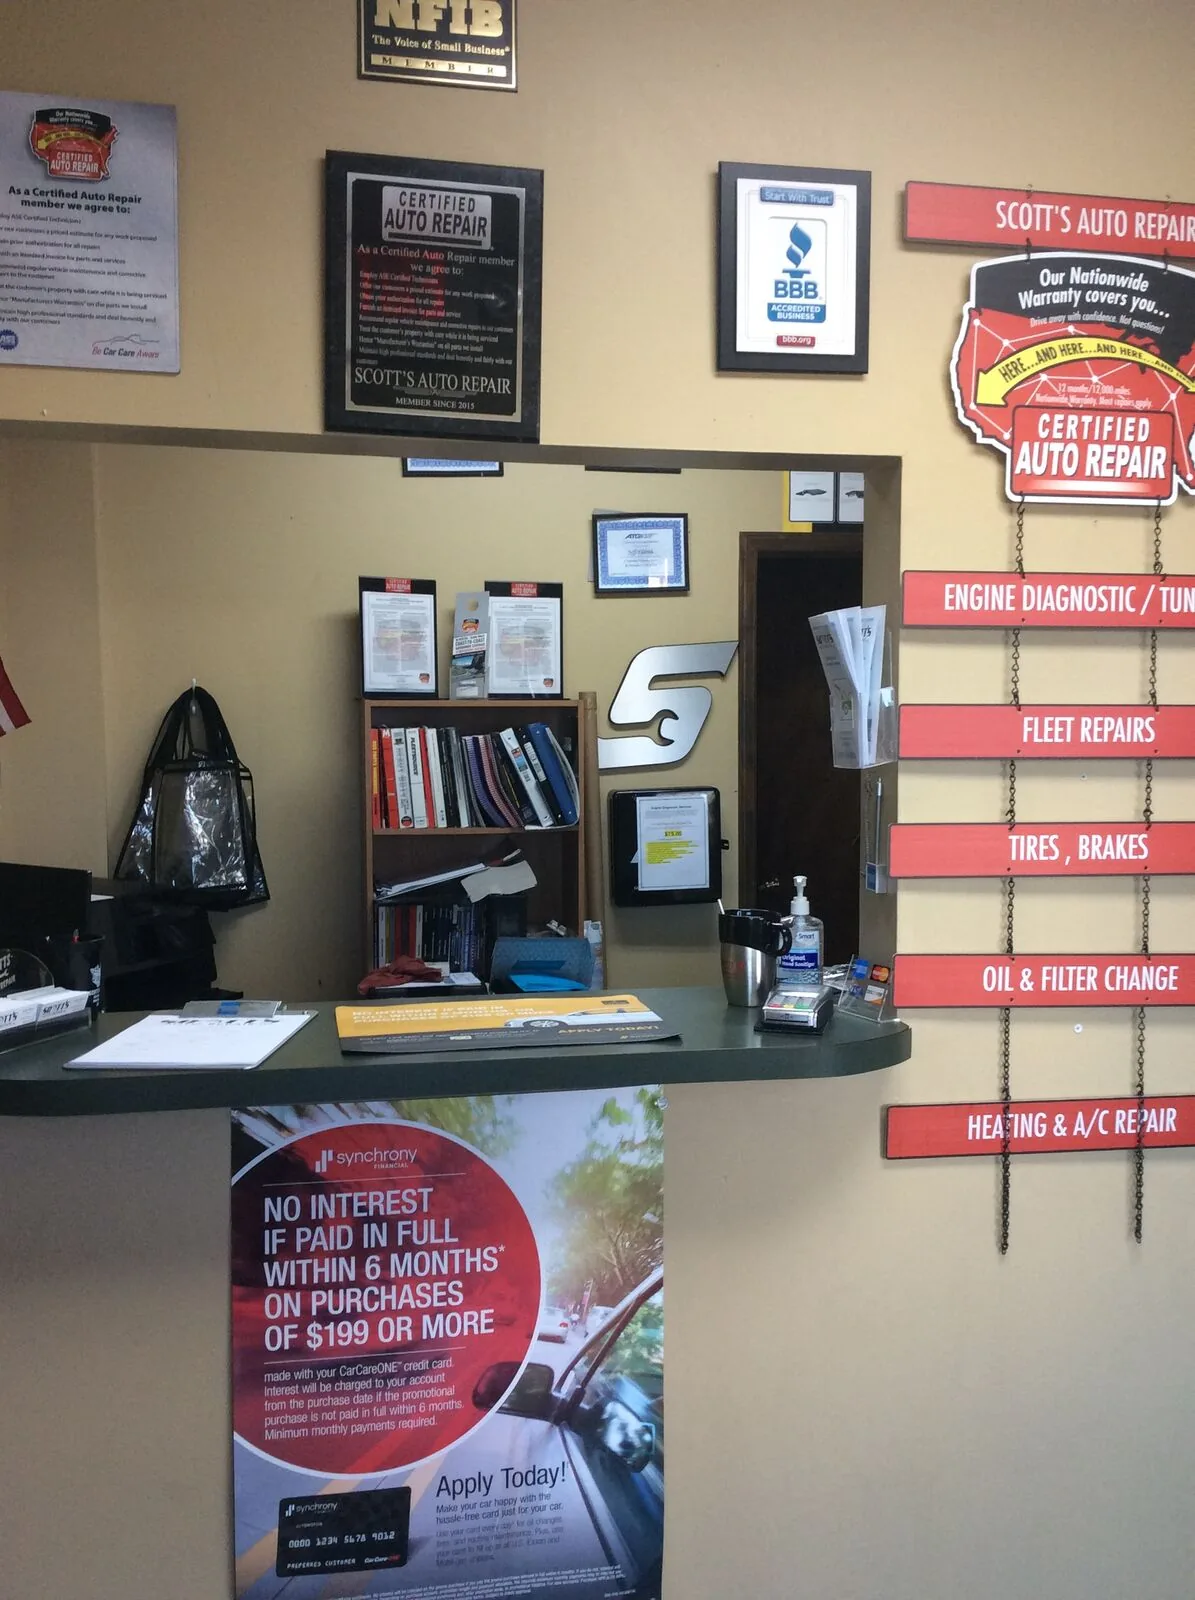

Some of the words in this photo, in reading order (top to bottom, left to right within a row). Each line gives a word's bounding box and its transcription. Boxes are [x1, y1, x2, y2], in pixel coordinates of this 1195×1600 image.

[374, 0, 503, 37] NFIB
[371, 34, 391, 46] The
[394, 37, 419, 49] Voice
[421, 39, 432, 50] of
[434, 41, 461, 53] Small
[50, 159, 70, 171] AUTO
[72, 162, 99, 173] REPAIR
[8, 185, 21, 196] As
[24, 188, 30, 197] a
[32, 186, 78, 200] Certified
[81, 191, 106, 202] Auto
[108, 192, 142, 206] Repair
[21, 199, 65, 210] member
[67, 202, 82, 211] we
[84, 204, 114, 215] agree
[116, 204, 131, 214] to:
[399, 190, 476, 213] CERTIFIED
[765, 191, 786, 201] Start
[788, 192, 807, 203] With
[810, 194, 830, 204] Trust
[384, 207, 427, 232] AUTO
[432, 212, 488, 238] REPAIR
[996, 200, 1072, 234] SCOTT'S
[1077, 207, 1129, 238] AUTO
[1134, 211, 1195, 243] REPAIR
[357, 243, 371, 255] As
[372, 246, 379, 255] a
[380, 245, 421, 259] Certified
[422, 249, 445, 261] Auto
[447, 251, 477, 265] Repair
[478, 253, 516, 267] member
[410, 263, 424, 273] we
[425, 264, 450, 276] agree
[1039, 268, 1066, 287] Our
[1069, 266, 1150, 293] Nationwide
[774, 279, 819, 300] BBB
[1018, 287, 1083, 311] Warranty
[1085, 288, 1128, 307] covers
[771, 304, 821, 313] ACCREDITED
[776, 311, 815, 320] BUSINESS
[1029, 316, 1048, 328] Drive
[1067, 310, 1081, 322] with
[103, 347, 117, 357] Car
[118, 347, 136, 358] Care
[782, 335, 812, 346] bbb.org
[355, 366, 415, 388] SCOTT'S
[418, 371, 458, 391] AUTO
[462, 375, 512, 395] REPAIR
[396, 397, 431, 408] MEMBER
[432, 398, 457, 410] SINCE
[459, 401, 475, 411] 2015
[1038, 412, 1151, 443] CERTIFIED
[1014, 440, 1079, 477] AUTO
[1085, 443, 1168, 480] REPAIR
[943, 583, 1017, 612] ENGINE
[1022, 585, 1137, 613] DIAGNOSTIC
[1022, 716, 1076, 743] FLEET
[1079, 716, 1157, 744] REPAIRS
[1008, 834, 1060, 862] TIRES
[1078, 833, 1150, 862] BRAKES
[982, 966, 1014, 992] OIL
[1019, 967, 1035, 992] &
[1041, 966, 1098, 992] FILTER
[1104, 965, 1180, 992] CHANGE
[1053, 1114, 1067, 1137] &
[1073, 1108, 1110, 1139] A/C
[1115, 1107, 1178, 1135] REPAIR
[336, 1147, 418, 1167] synchrony
[264, 1195, 301, 1223] NO
[310, 1187, 434, 1221] INTEREST
[264, 1228, 286, 1256] IF
[295, 1224, 354, 1253] PAID
[363, 1222, 388, 1249] IN
[397, 1217, 459, 1248] FULL
[263, 1256, 356, 1288] WITHIN
[365, 1253, 381, 1281] 6
[264, 1291, 301, 1320] ON
[311, 1280, 464, 1317] PURCHASES
[264, 1323, 299, 1353] OF
[306, 1318, 370, 1352] $199
[378, 1315, 413, 1343] OR
[421, 1308, 495, 1341] MORE
[264, 1369, 291, 1383] made
[294, 1368, 314, 1380] with
[316, 1369, 336, 1381] your
[403, 1358, 430, 1372] credit
[264, 1383, 300, 1397] Interest
[301, 1382, 317, 1395] will
[319, 1380, 333, 1392] be
[334, 1377, 373, 1394] charged
[374, 1377, 384, 1388] to
[386, 1378, 406, 1390] your
[409, 1373, 446, 1386] account
[264, 1400, 287, 1412] from
[289, 1398, 305, 1409] the
[307, 1394, 350, 1411] purchase
[352, 1392, 373, 1405] date
[375, 1391, 382, 1402] if
[384, 1390, 400, 1402] the
[402, 1384, 456, 1402] promotional
[264, 1413, 308, 1428] purchase
[310, 1411, 319, 1422] is
[321, 1410, 337, 1422] not
[339, 1405, 360, 1421] paid
[361, 1406, 370, 1417] in
[373, 1404, 387, 1417] full
[389, 1402, 417, 1416] within
[418, 1402, 427, 1413] 6
[264, 1426, 309, 1441] Minimum
[311, 1423, 348, 1439] monthly
[350, 1418, 396, 1435] payments
[436, 1471, 494, 1500] Apply
[501, 1461, 566, 1490] Today!
[296, 1502, 338, 1514] synchrony
[436, 1503, 459, 1514] Make
[460, 1502, 478, 1513] your
[479, 1499, 493, 1509] car
[494, 1496, 518, 1509] happy
[519, 1494, 537, 1505] with
[538, 1491, 552, 1502] the
[436, 1511, 480, 1525] hassle-free
[481, 1508, 500, 1520] card
[501, 1506, 517, 1519] just
[517, 1504, 529, 1516] for
[530, 1503, 548, 1515] your
[288, 1539, 311, 1549] 0000
[316, 1537, 338, 1547] 1234
[344, 1533, 367, 1544] 5678
[372, 1530, 396, 1541] 9012
[325, 1558, 357, 1568] CUSTOMER
